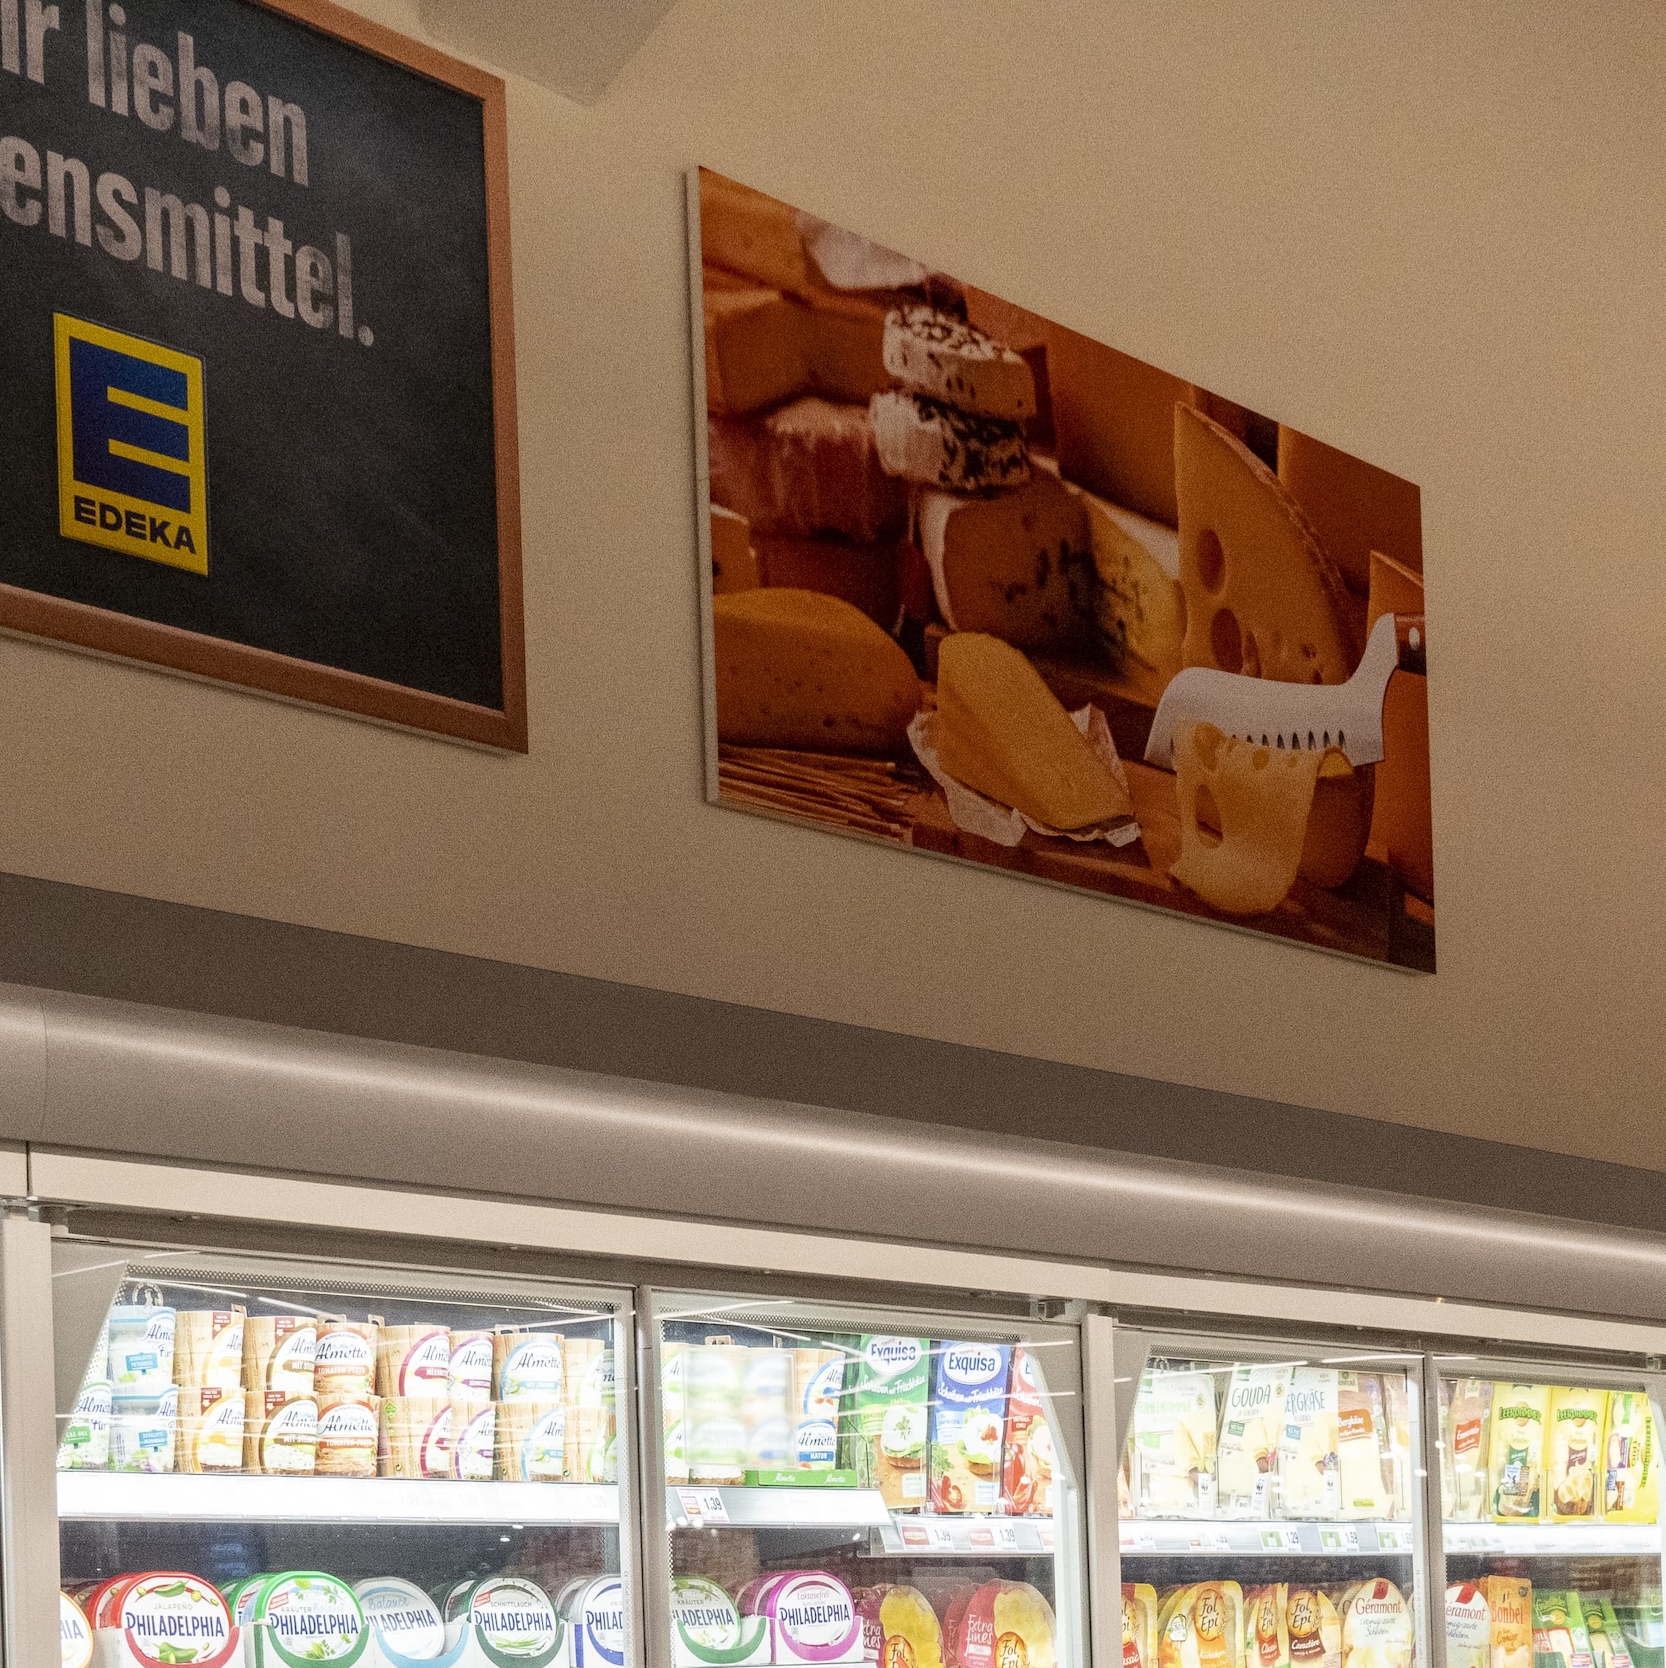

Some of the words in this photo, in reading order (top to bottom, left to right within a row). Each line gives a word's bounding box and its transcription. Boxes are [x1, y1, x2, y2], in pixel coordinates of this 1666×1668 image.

[86, 0, 311, 187] lieben
[74, 497, 197, 554] EDEKA
[317, 1345, 367, 1364] Almette
[517, 1353, 561, 1371] Almette
[871, 1342, 917, 1365] Exquisa
[947, 1352, 997, 1374] Exquisa
[1231, 1383, 1271, 1408] GOUDA
[779, 1606, 851, 1626] PHILADELPHIA
[1355, 1598, 1405, 1618] Géramont
[1491, 1602, 1525, 1625] Bonbel
[125, 1610, 225, 1638] PHILADELPHIA
[270, 1611, 359, 1636] PHILADELPHIA
[474, 1610, 553, 1633] PHILADELPHIA
